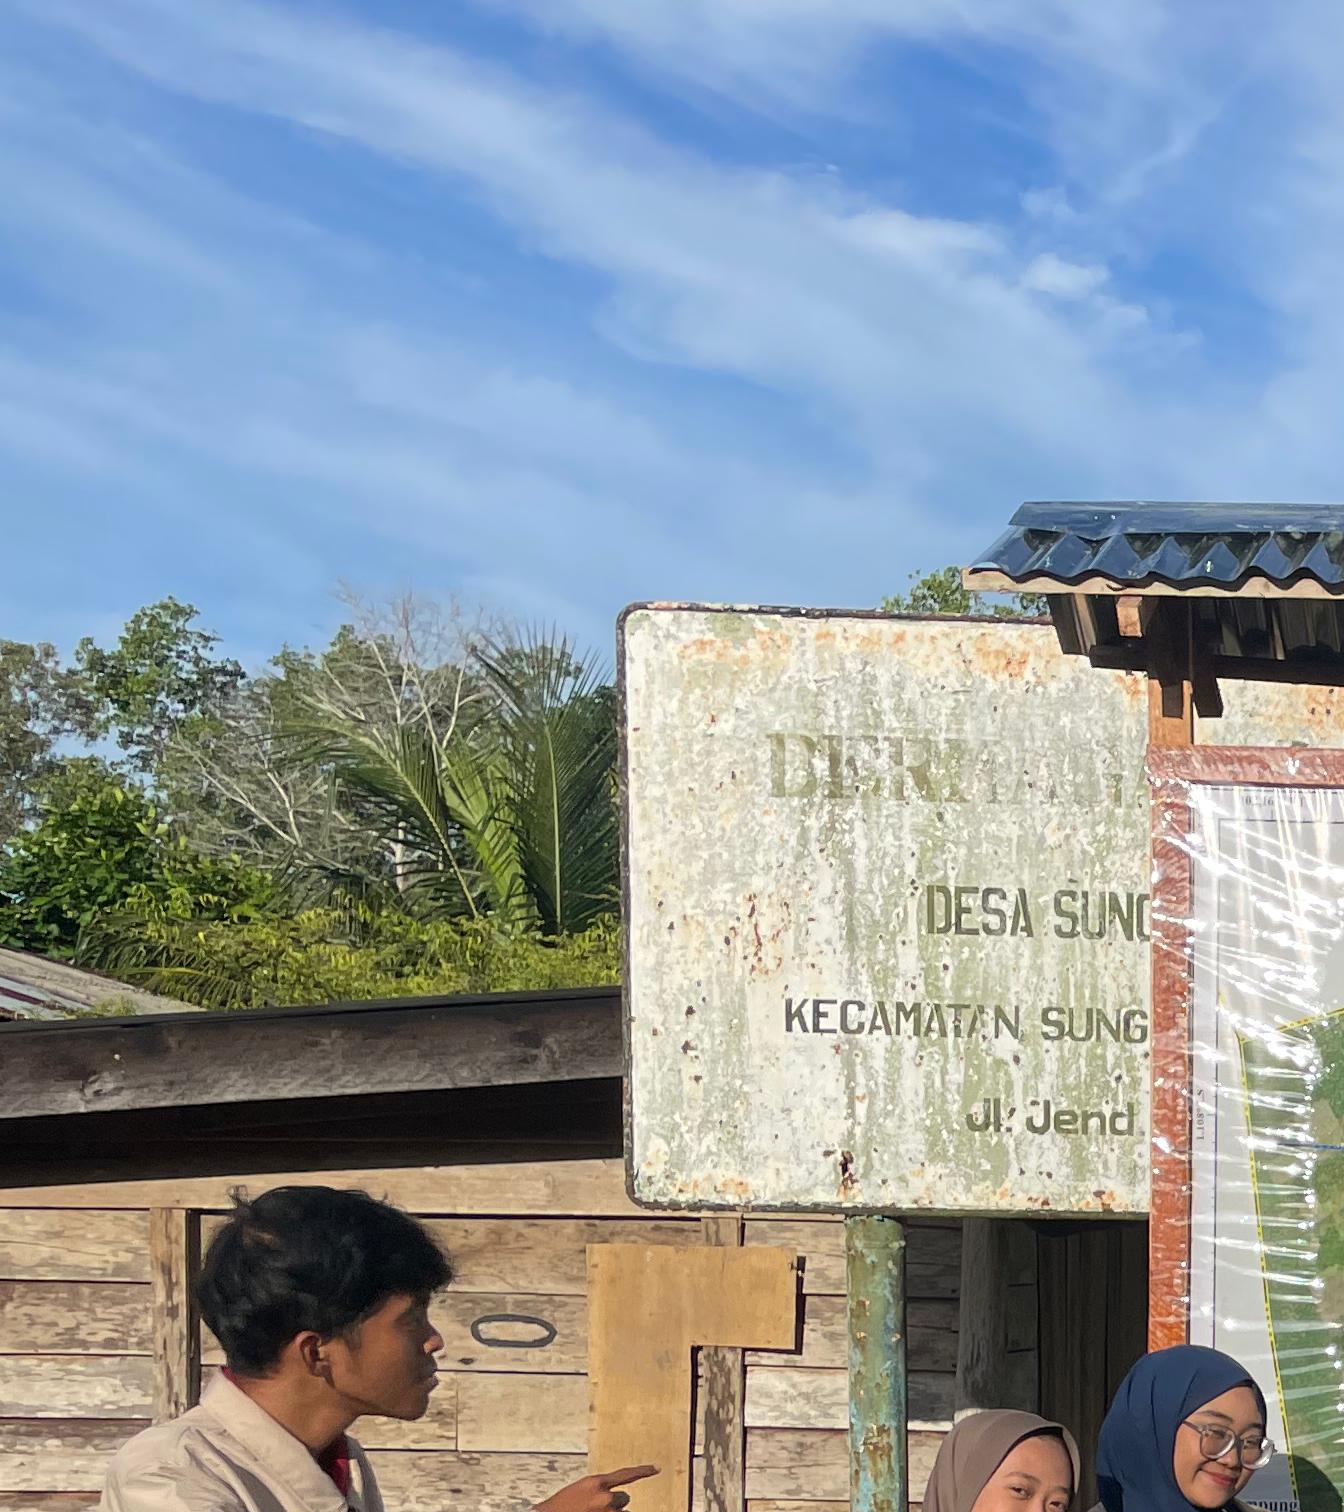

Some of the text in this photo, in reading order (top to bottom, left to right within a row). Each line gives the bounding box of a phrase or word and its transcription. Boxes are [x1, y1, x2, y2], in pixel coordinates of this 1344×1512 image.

[927, 885, 1033, 938] DESA
[784, 998, 1149, 1044] KECAMATAN SUNG
